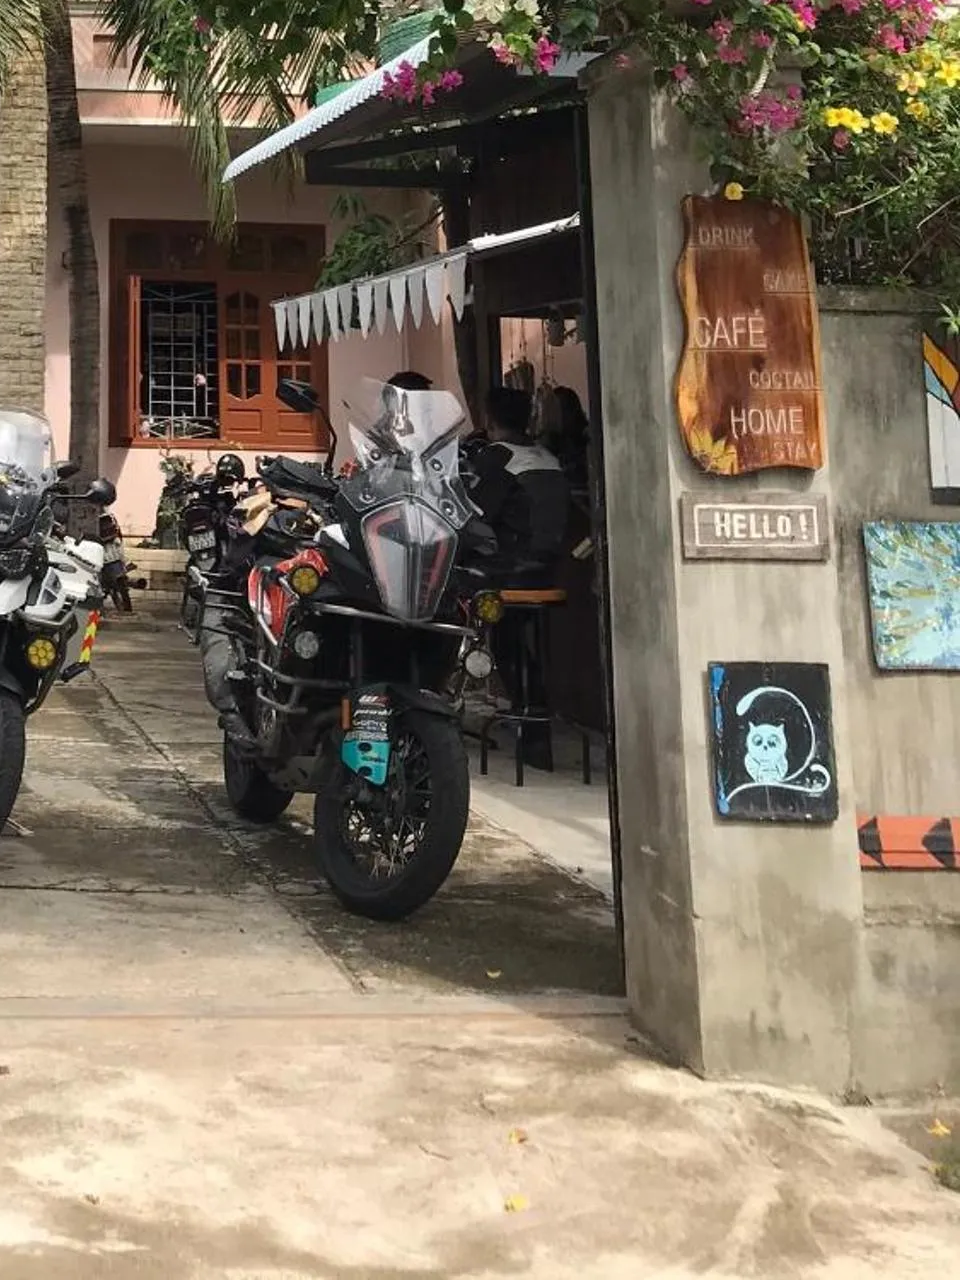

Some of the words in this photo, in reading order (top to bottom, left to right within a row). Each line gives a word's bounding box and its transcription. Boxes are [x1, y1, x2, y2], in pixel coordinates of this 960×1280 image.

[698, 226, 754, 245] DRINK
[694, 308, 767, 348] CAFÉ
[730, 407, 804, 439] HOME
[773, 441, 817, 461] STAY
